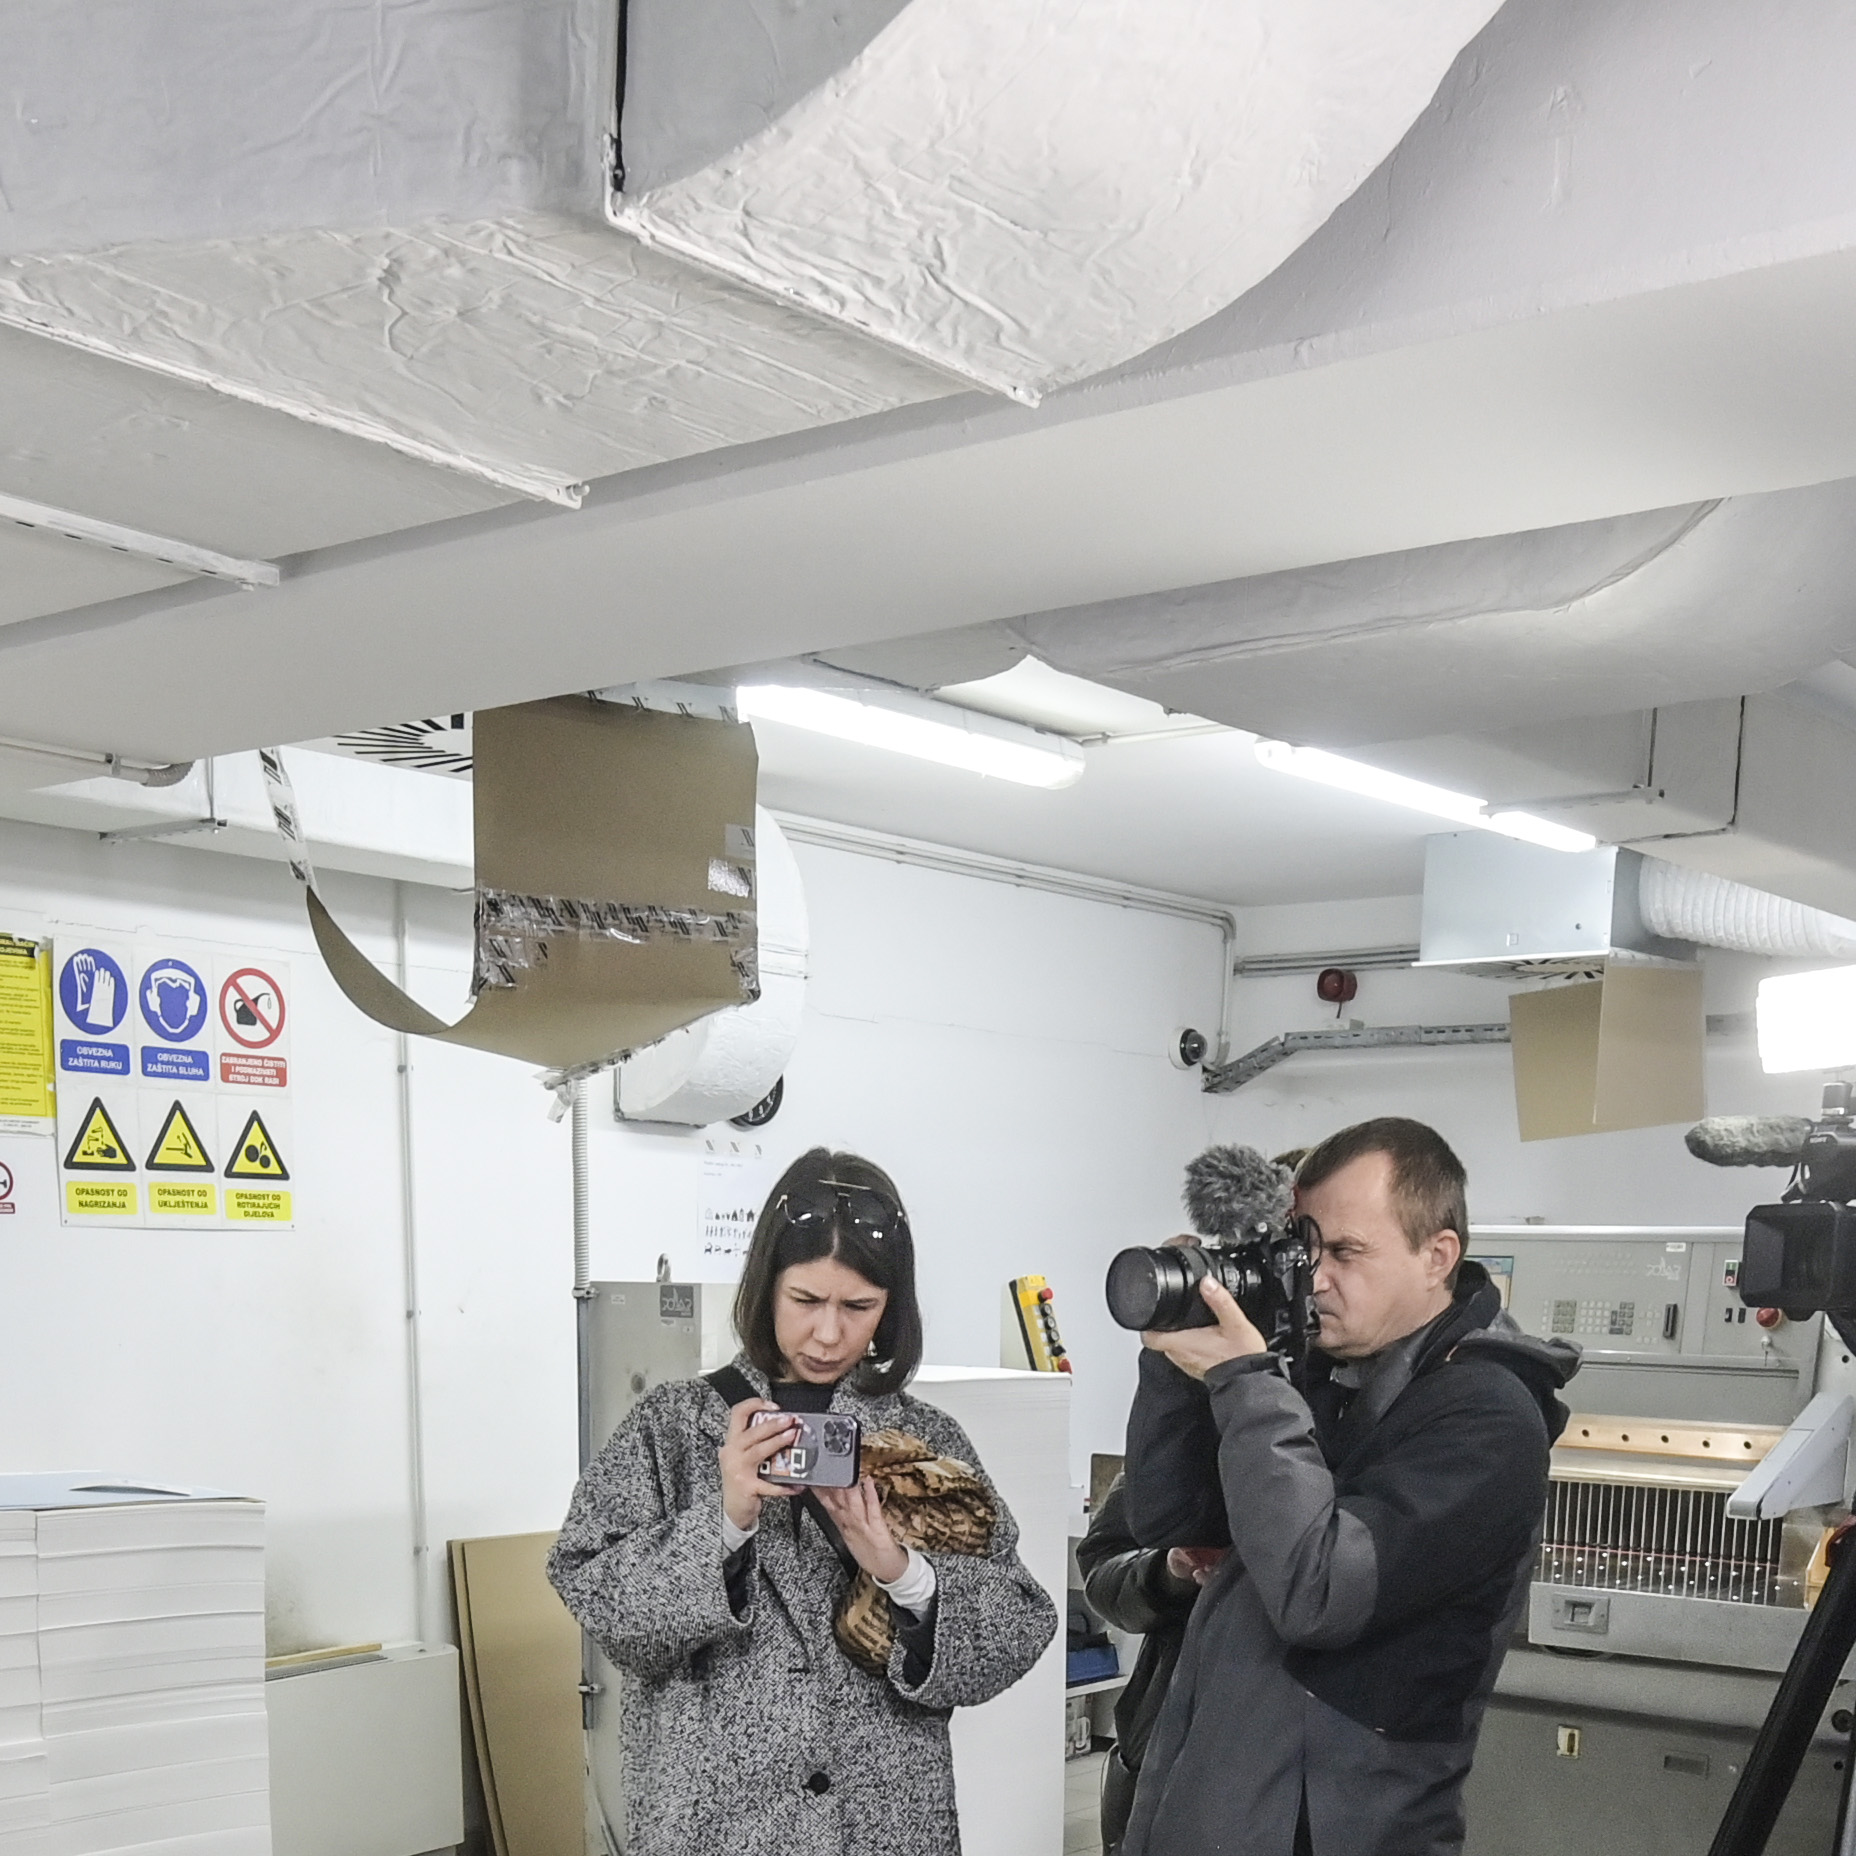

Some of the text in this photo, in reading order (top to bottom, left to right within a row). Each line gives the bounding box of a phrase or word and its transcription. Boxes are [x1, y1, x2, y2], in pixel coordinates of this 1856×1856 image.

[76, 1046, 114, 1057] OBVEZNA
[68, 1057, 123, 1070] ZAŠTITA RUKU
[157, 1053, 194, 1064] OBVEZNA
[147, 1063, 204, 1076] ZAŠTITA SLUHA
[75, 1187, 128, 1197] OPASNOST OD
[157, 1188, 207, 1198] OPASNOST OD
[235, 1192, 281, 1201] OPASNOST OD
[78, 1200, 127, 1209] NAGRIZANJA
[157, 1199, 209, 1209] UKLJEŠTENJA
[243, 1210, 275, 1218] DIJELOVA
